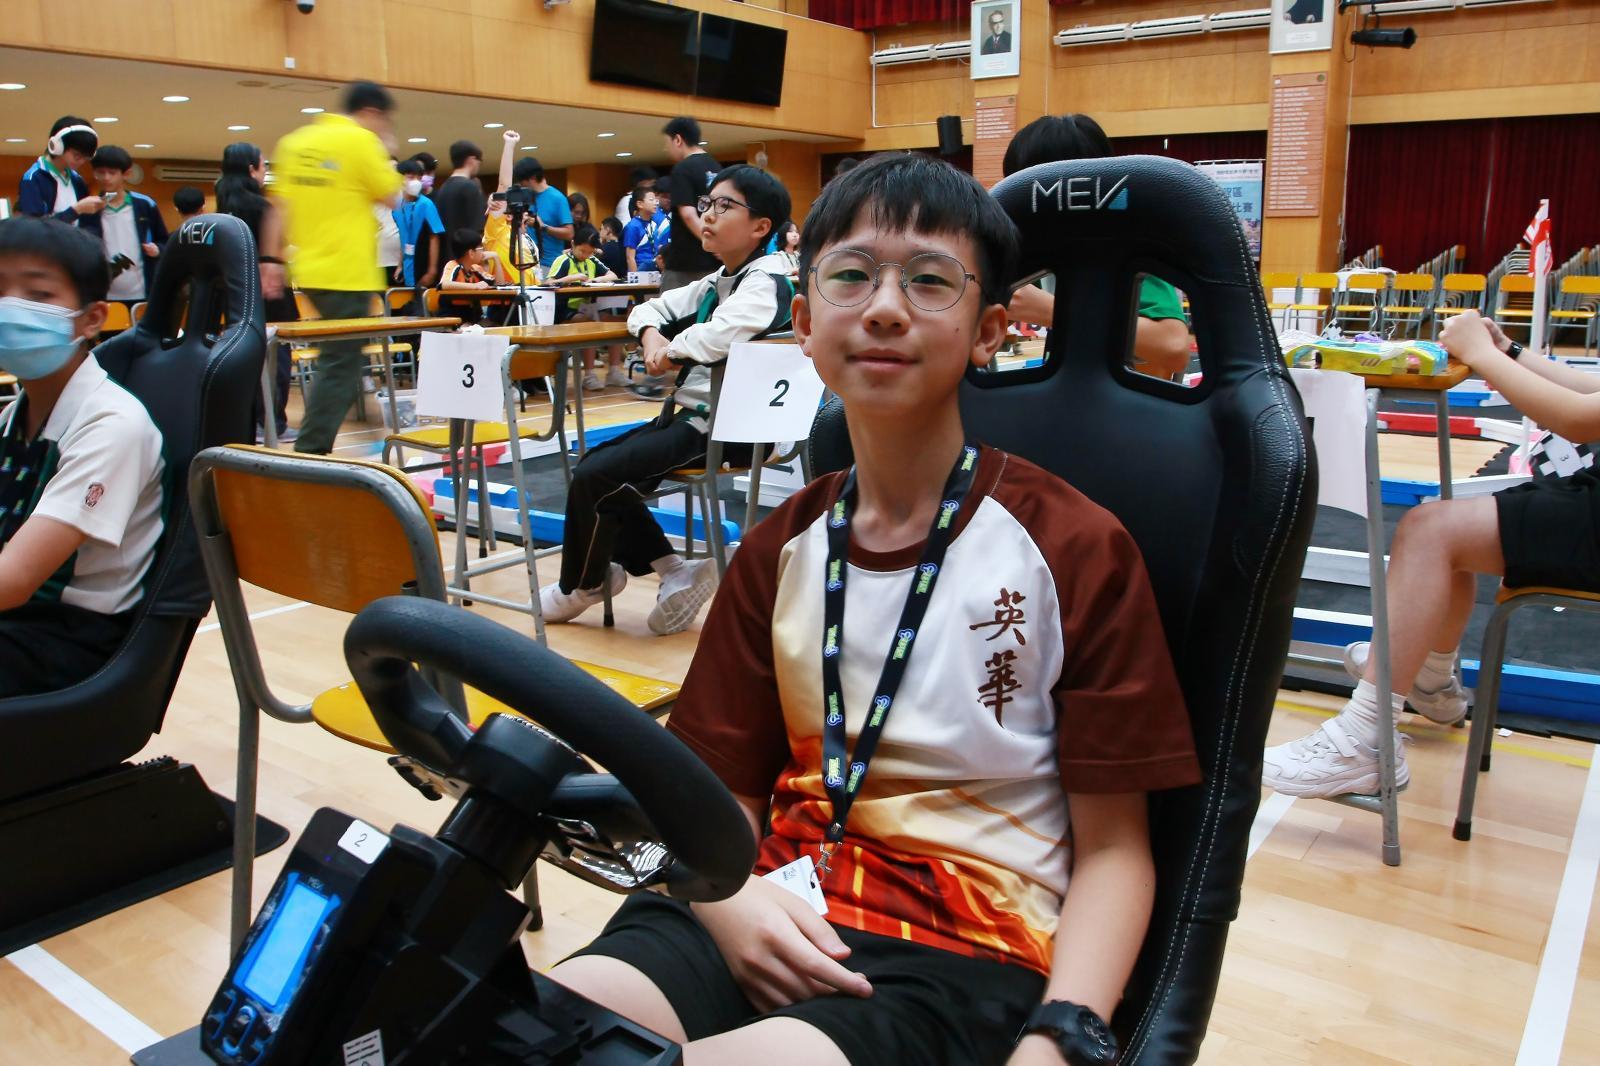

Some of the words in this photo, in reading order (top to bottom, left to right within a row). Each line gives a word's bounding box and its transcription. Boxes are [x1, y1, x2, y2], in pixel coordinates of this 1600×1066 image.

[1032, 175, 1129, 213] MEV
[179, 222, 216, 244] MEV
[462, 364, 474, 388] 3
[769, 379, 790, 407] 2
[969, 587, 1026, 729] 英華
[354, 833, 368, 848] 2
